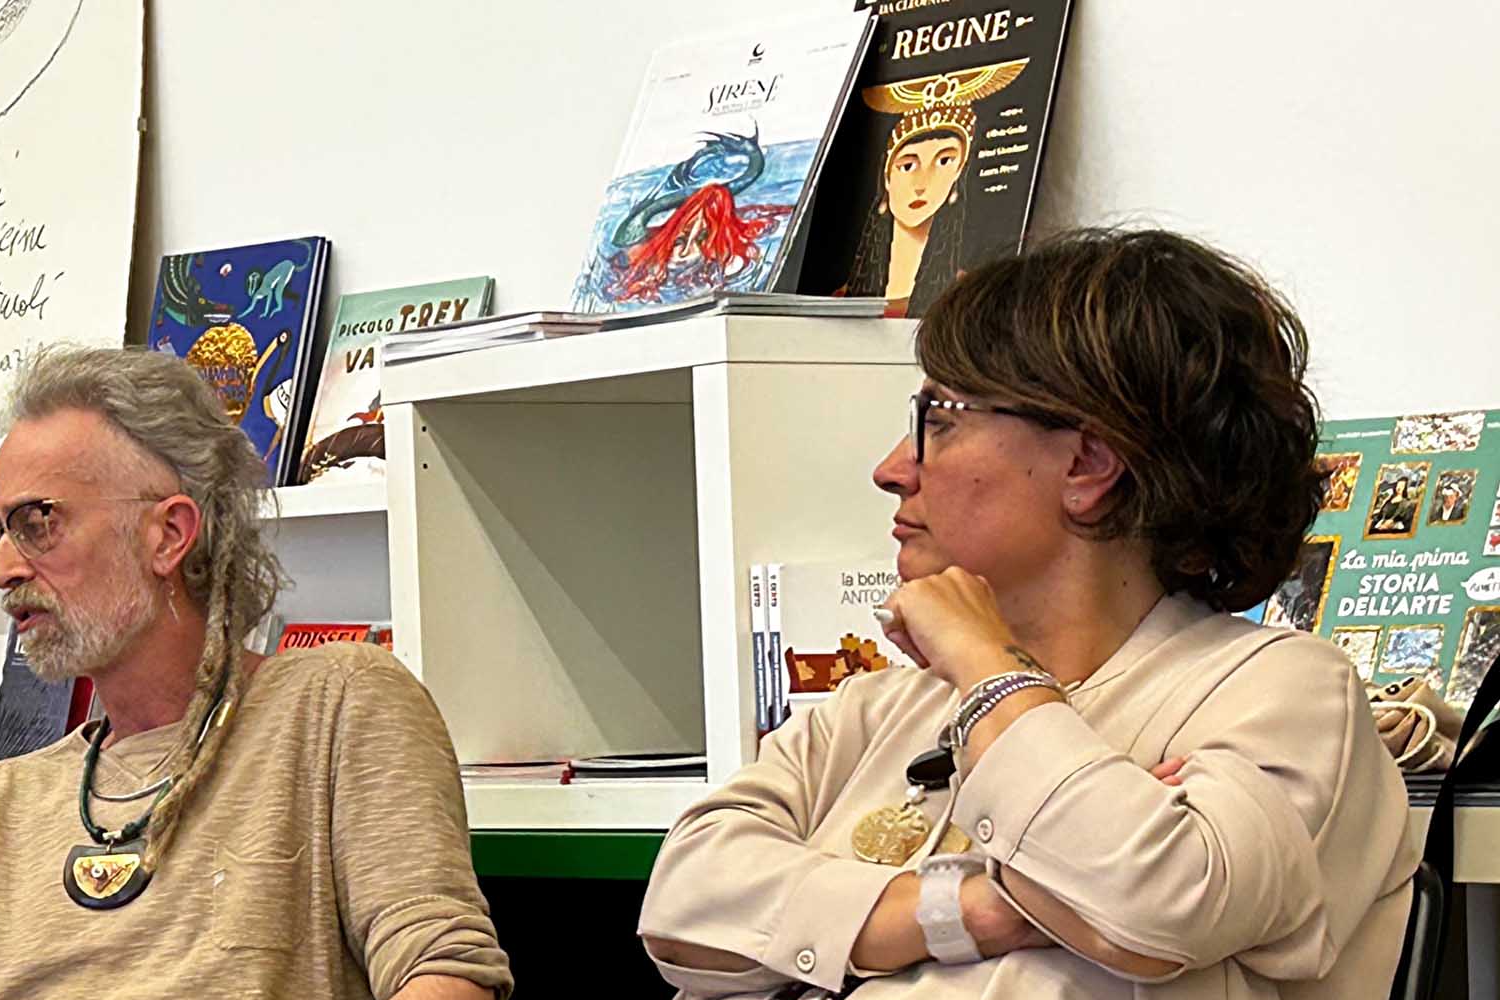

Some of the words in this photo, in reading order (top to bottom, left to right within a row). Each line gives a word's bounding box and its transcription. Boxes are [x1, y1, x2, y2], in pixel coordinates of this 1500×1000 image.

[891, 10, 1011, 60] REGINE
[707, 74, 783, 112] SIRENE
[339, 318, 394, 338] PICCOLO
[1340, 549, 1367, 570] La
[1371, 549, 1407, 568] mia
[1405, 547, 1470, 572] prima
[841, 572, 854, 587] la
[1358, 572, 1440, 594] STORIA
[1337, 594, 1454, 617] DELL'ARTE
